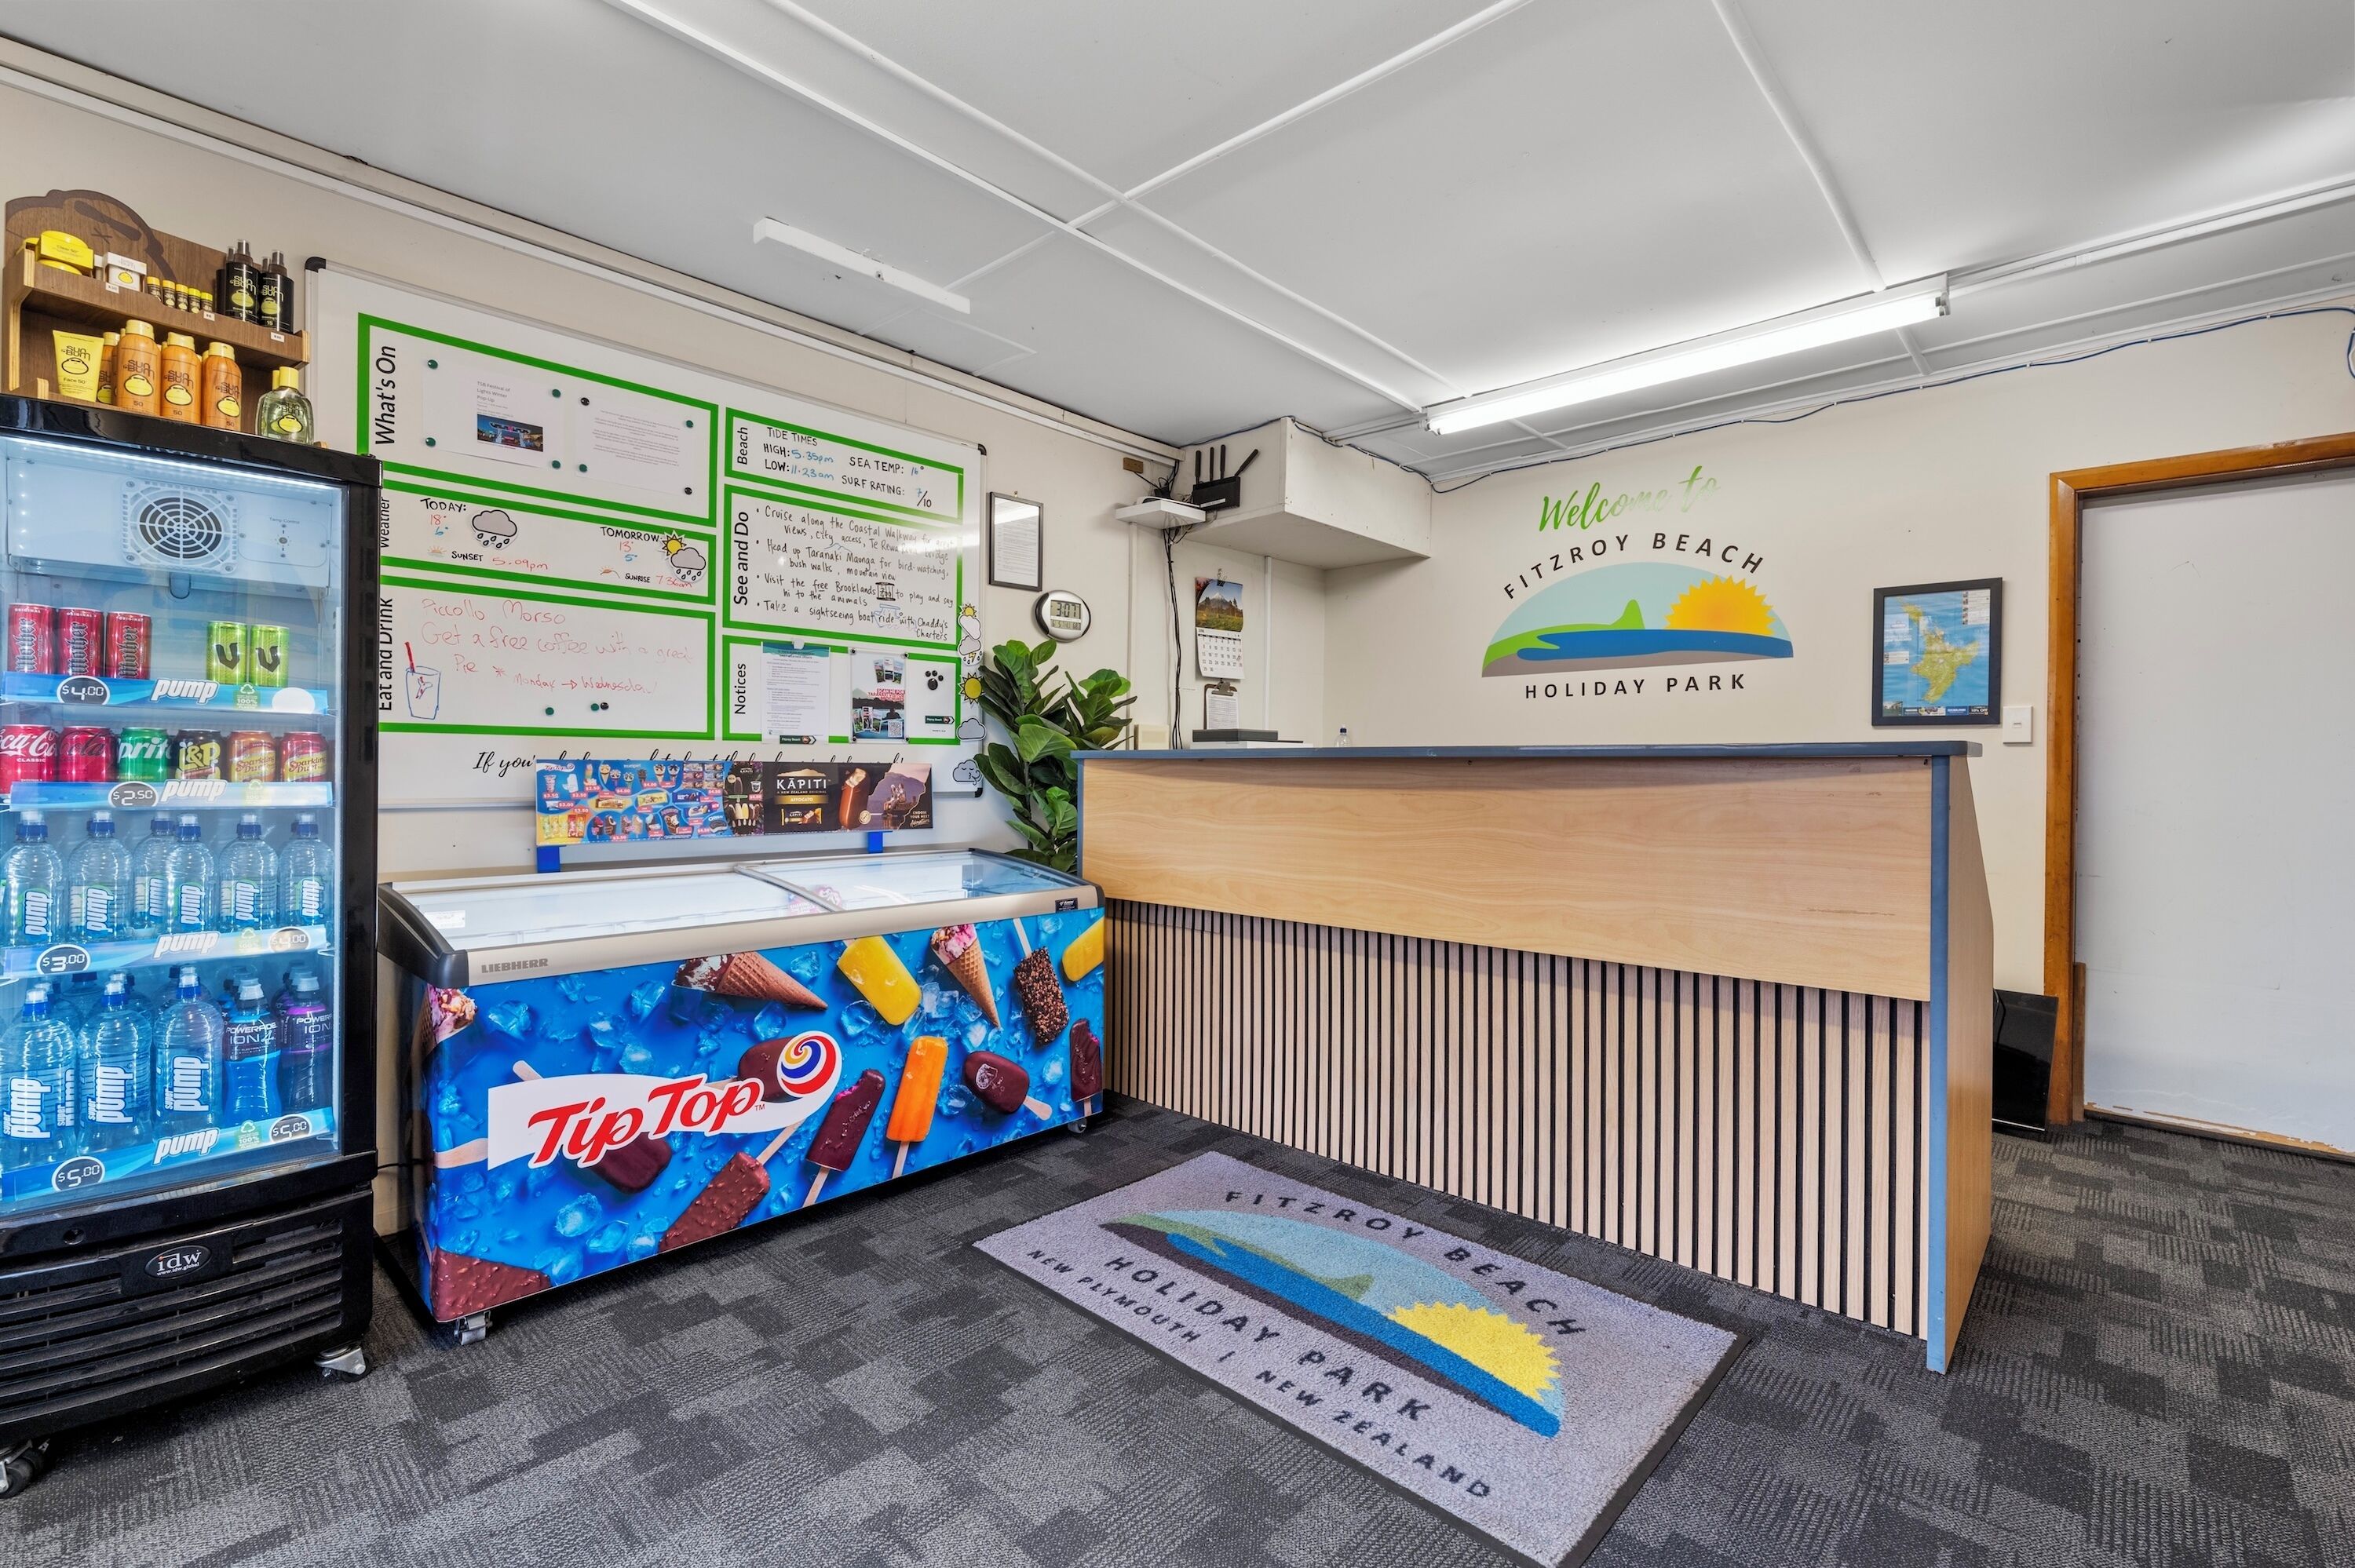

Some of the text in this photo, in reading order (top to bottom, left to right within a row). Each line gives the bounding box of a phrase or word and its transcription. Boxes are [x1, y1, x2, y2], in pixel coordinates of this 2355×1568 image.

[65, 350, 91, 362] BUM
[67, 345, 87, 355] SUN
[127, 364, 155, 380] BUM
[128, 359, 152, 371] SUN
[168, 370, 190, 381] SUN
[167, 374, 195, 389] BUM
[374, 346, 396, 445] What's On
[736, 426, 748, 465] Beach
[766, 426, 818, 447] TIDE TIMES
[763, 443, 790, 458] HIGH:
[765, 458, 790, 472] LOW:
[849, 456, 871, 470] SEA
[874, 460, 904, 474] TEMP:
[842, 475, 867, 489] SURF
[870, 480, 905, 496] RATING:
[420, 498, 467, 513] TODAY:
[1538, 465, 1722, 533] Welcome to
[765, 505, 917, 542] Cruise along the Coastal Walkway
[451, 550, 484, 562] SUNSET
[767, 538, 787, 554] Head
[792, 548, 801, 559] up
[805, 546, 842, 561] Taranaki
[846, 552, 875, 571] Maunga
[879, 556, 892, 569] for
[869, 538, 878, 550] Te
[881, 539, 899, 552] Rewa
[733, 511, 750, 606] See and Do
[789, 557, 807, 568] bush
[846, 566, 878, 578] mountain
[1503, 532, 1765, 600] FITZROY BEACH
[625, 572, 652, 583] SUNRISE
[764, 573, 784, 586] Visit
[790, 578, 805, 589] the
[812, 579, 829, 593] free
[834, 580, 876, 596] Brooklands
[896, 589, 904, 597] to
[909, 592, 924, 605] play
[928, 594, 940, 603] and
[943, 597, 954, 608] say
[783, 588, 867, 607] hi to the animals
[379, 597, 393, 645] Drink
[502, 600, 566, 625] Morso
[763, 600, 787, 612] Take
[809, 607, 854, 625] sightseeing
[858, 610, 874, 624] boat
[878, 611, 894, 624] ride
[421, 621, 462, 646] Get
[473, 633, 485, 647] a
[489, 625, 528, 651] free
[537, 632, 590, 655] coffee
[916, 628, 947, 641] Charters
[378, 649, 392, 680] and
[62, 685, 104, 701] $4.00
[150, 679, 219, 704] pump
[733, 662, 747, 715] Notices
[1524, 673, 1746, 699] HOLIDAY PARK
[178, 741, 221, 771] L&P
[473, 751, 495, 775] If
[160, 780, 227, 802] pump
[776, 776, 827, 791] KĀPITI
[112, 789, 153, 807] $2.50
[86, 888, 115, 933] pump
[180, 884, 206, 926] pump
[235, 881, 260, 922] pump
[301, 878, 325, 918] pump
[24, 891, 53, 937] pump
[153, 932, 220, 959] pump
[42, 954, 86, 973] $3.00
[481, 957, 549, 975] LIEBHERR
[225, 1022, 277, 1034] POWERADE
[95, 1066, 133, 1123] pump
[173, 1056, 210, 1112] pump
[10, 1078, 53, 1139] pump
[528, 1096, 644, 1165] Tip
[648, 1077, 761, 1136] Top
[272, 1121, 308, 1139] $5.00
[153, 1129, 219, 1165] pump
[58, 1165, 100, 1187] $5.00
[156, 1261, 200, 1276] www.idw.global
[157, 1249, 202, 1272] idw
[1225, 1190, 1586, 1336] FITZROY BEACH
[1104, 1256, 1432, 1422] HOLIDAY PARK
[1026, 1249, 1492, 1498] NEW PLYMOUTH NEW ZEALAND
